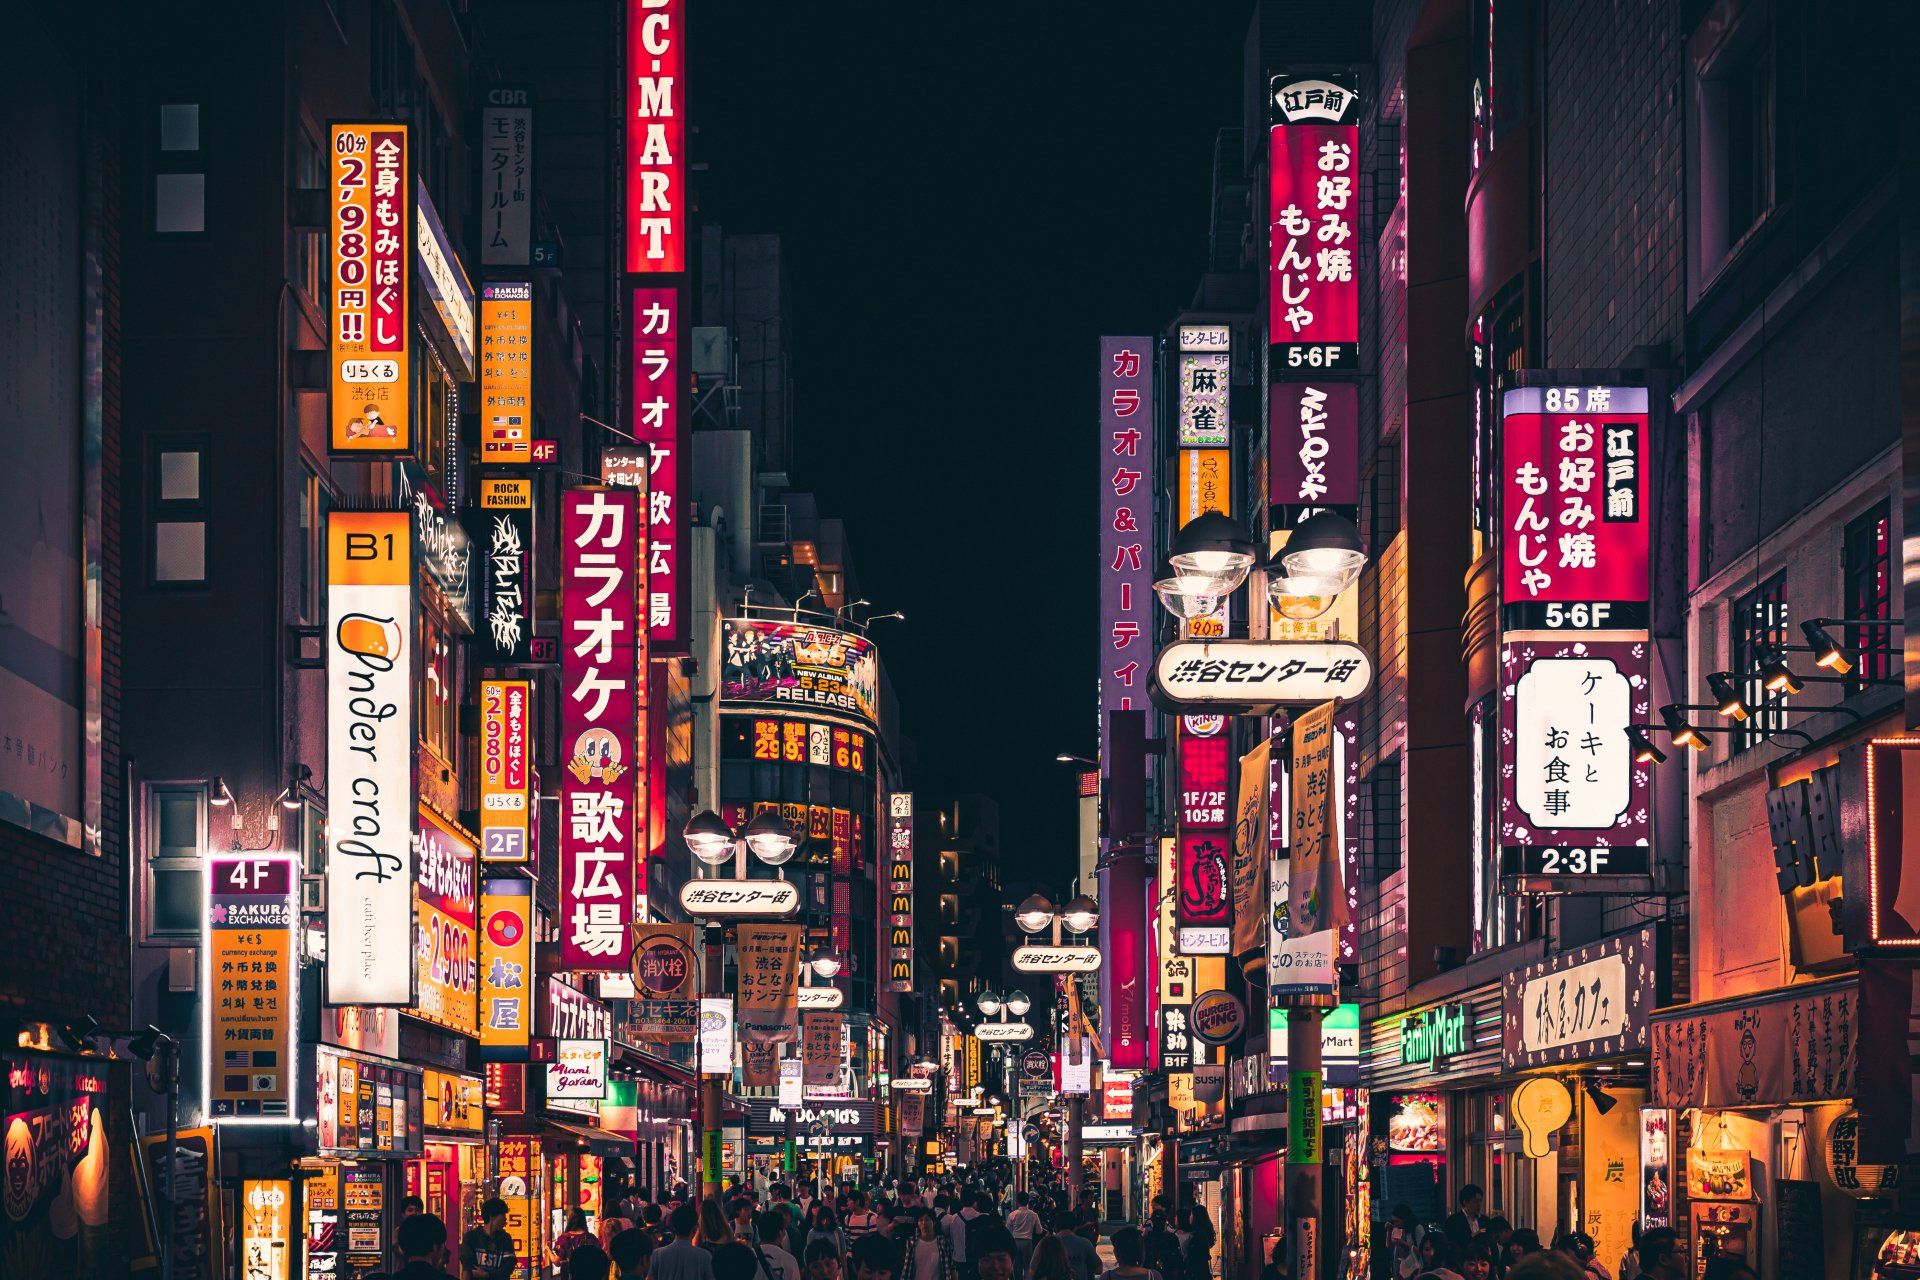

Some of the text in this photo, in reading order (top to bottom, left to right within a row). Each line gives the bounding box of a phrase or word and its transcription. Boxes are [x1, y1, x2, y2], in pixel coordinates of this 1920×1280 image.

[488, 89, 527, 105] CBR
[1283, 89, 1345, 113] 江戸前
[639, 0, 674, 259] C-MART
[335, 132, 367, 153] 60分
[490, 117, 510, 248] モニタールーム
[1316, 140, 1352, 283] お好み焼
[374, 138, 400, 345] 全身もみほぐし
[1277, 203, 1314, 333] もんじゃ
[1181, 331, 1228, 346] センタービル
[1214, 356, 1229, 366] 5F
[346, 364, 394, 378] りらくる
[353, 386, 389, 401] 渋谷店
[1192, 367, 1217, 430] 麻雀
[1545, 386, 1611, 412] 85席
[533, 444, 555, 459] 4F
[1606, 428, 1634, 518] 江戸前
[494, 483, 520, 494] ROCK
[1558, 419, 1597, 569] お好み焼
[487, 495, 527, 506] FASHION
[1513, 461, 1551, 597] もんじゃ
[346, 533, 394, 561] B1
[535, 642, 553, 659] 3F
[797, 670, 843, 682] NEW ALBUM
[1168, 658, 1362, 684] 渋谷センター街
[776, 686, 857, 710] RELEASE
[570, 493, 626, 957] カラオケ 歌広場
[1580, 670, 1604, 784] ケーキと
[509, 690, 522, 786] 全身もみほぐし
[1543, 726, 1572, 817] お食事
[487, 797, 522, 808] りらくる
[1182, 791, 1226, 806] 1F/2F
[1184, 807, 1225, 822] 105席
[490, 833, 519, 853] 2F
[229, 860, 270, 889] 4F
[418, 828, 475, 914] 全身もみほぐし
[686, 889, 792, 904] 渋谷センター街
[228, 904, 291, 915] SAKURA
[1181, 933, 1229, 947] センタービル
[221, 949, 278, 958] currency exchange
[1017, 953, 1098, 965] 渋谷センター街
[1295, 951, 1328, 959] ステッカー
[643, 958, 684, 977] 消火栓
[755, 956, 784, 970] 渋谷
[742, 973, 794, 986] おとなり
[487, 956, 523, 1031] 松屋
[742, 989, 795, 1001] サンデー
[1198, 1002, 1235, 1021] BURGER
[1536, 975, 1609, 1044] 椿屋カフェ
[745, 1022, 792, 1031] Panasonic
[1200, 1010, 1237, 1032] KING
[224, 1028, 274, 1041] 外貨両替
[977, 1028, 1029, 1037] 渋谷センター街
[1400, 1006, 1465, 1072] FamilyMart
[549, 1063, 591, 1076] Miami
[1165, 1057, 1188, 1067] B1F
[1171, 1077, 1194, 1091] すし
